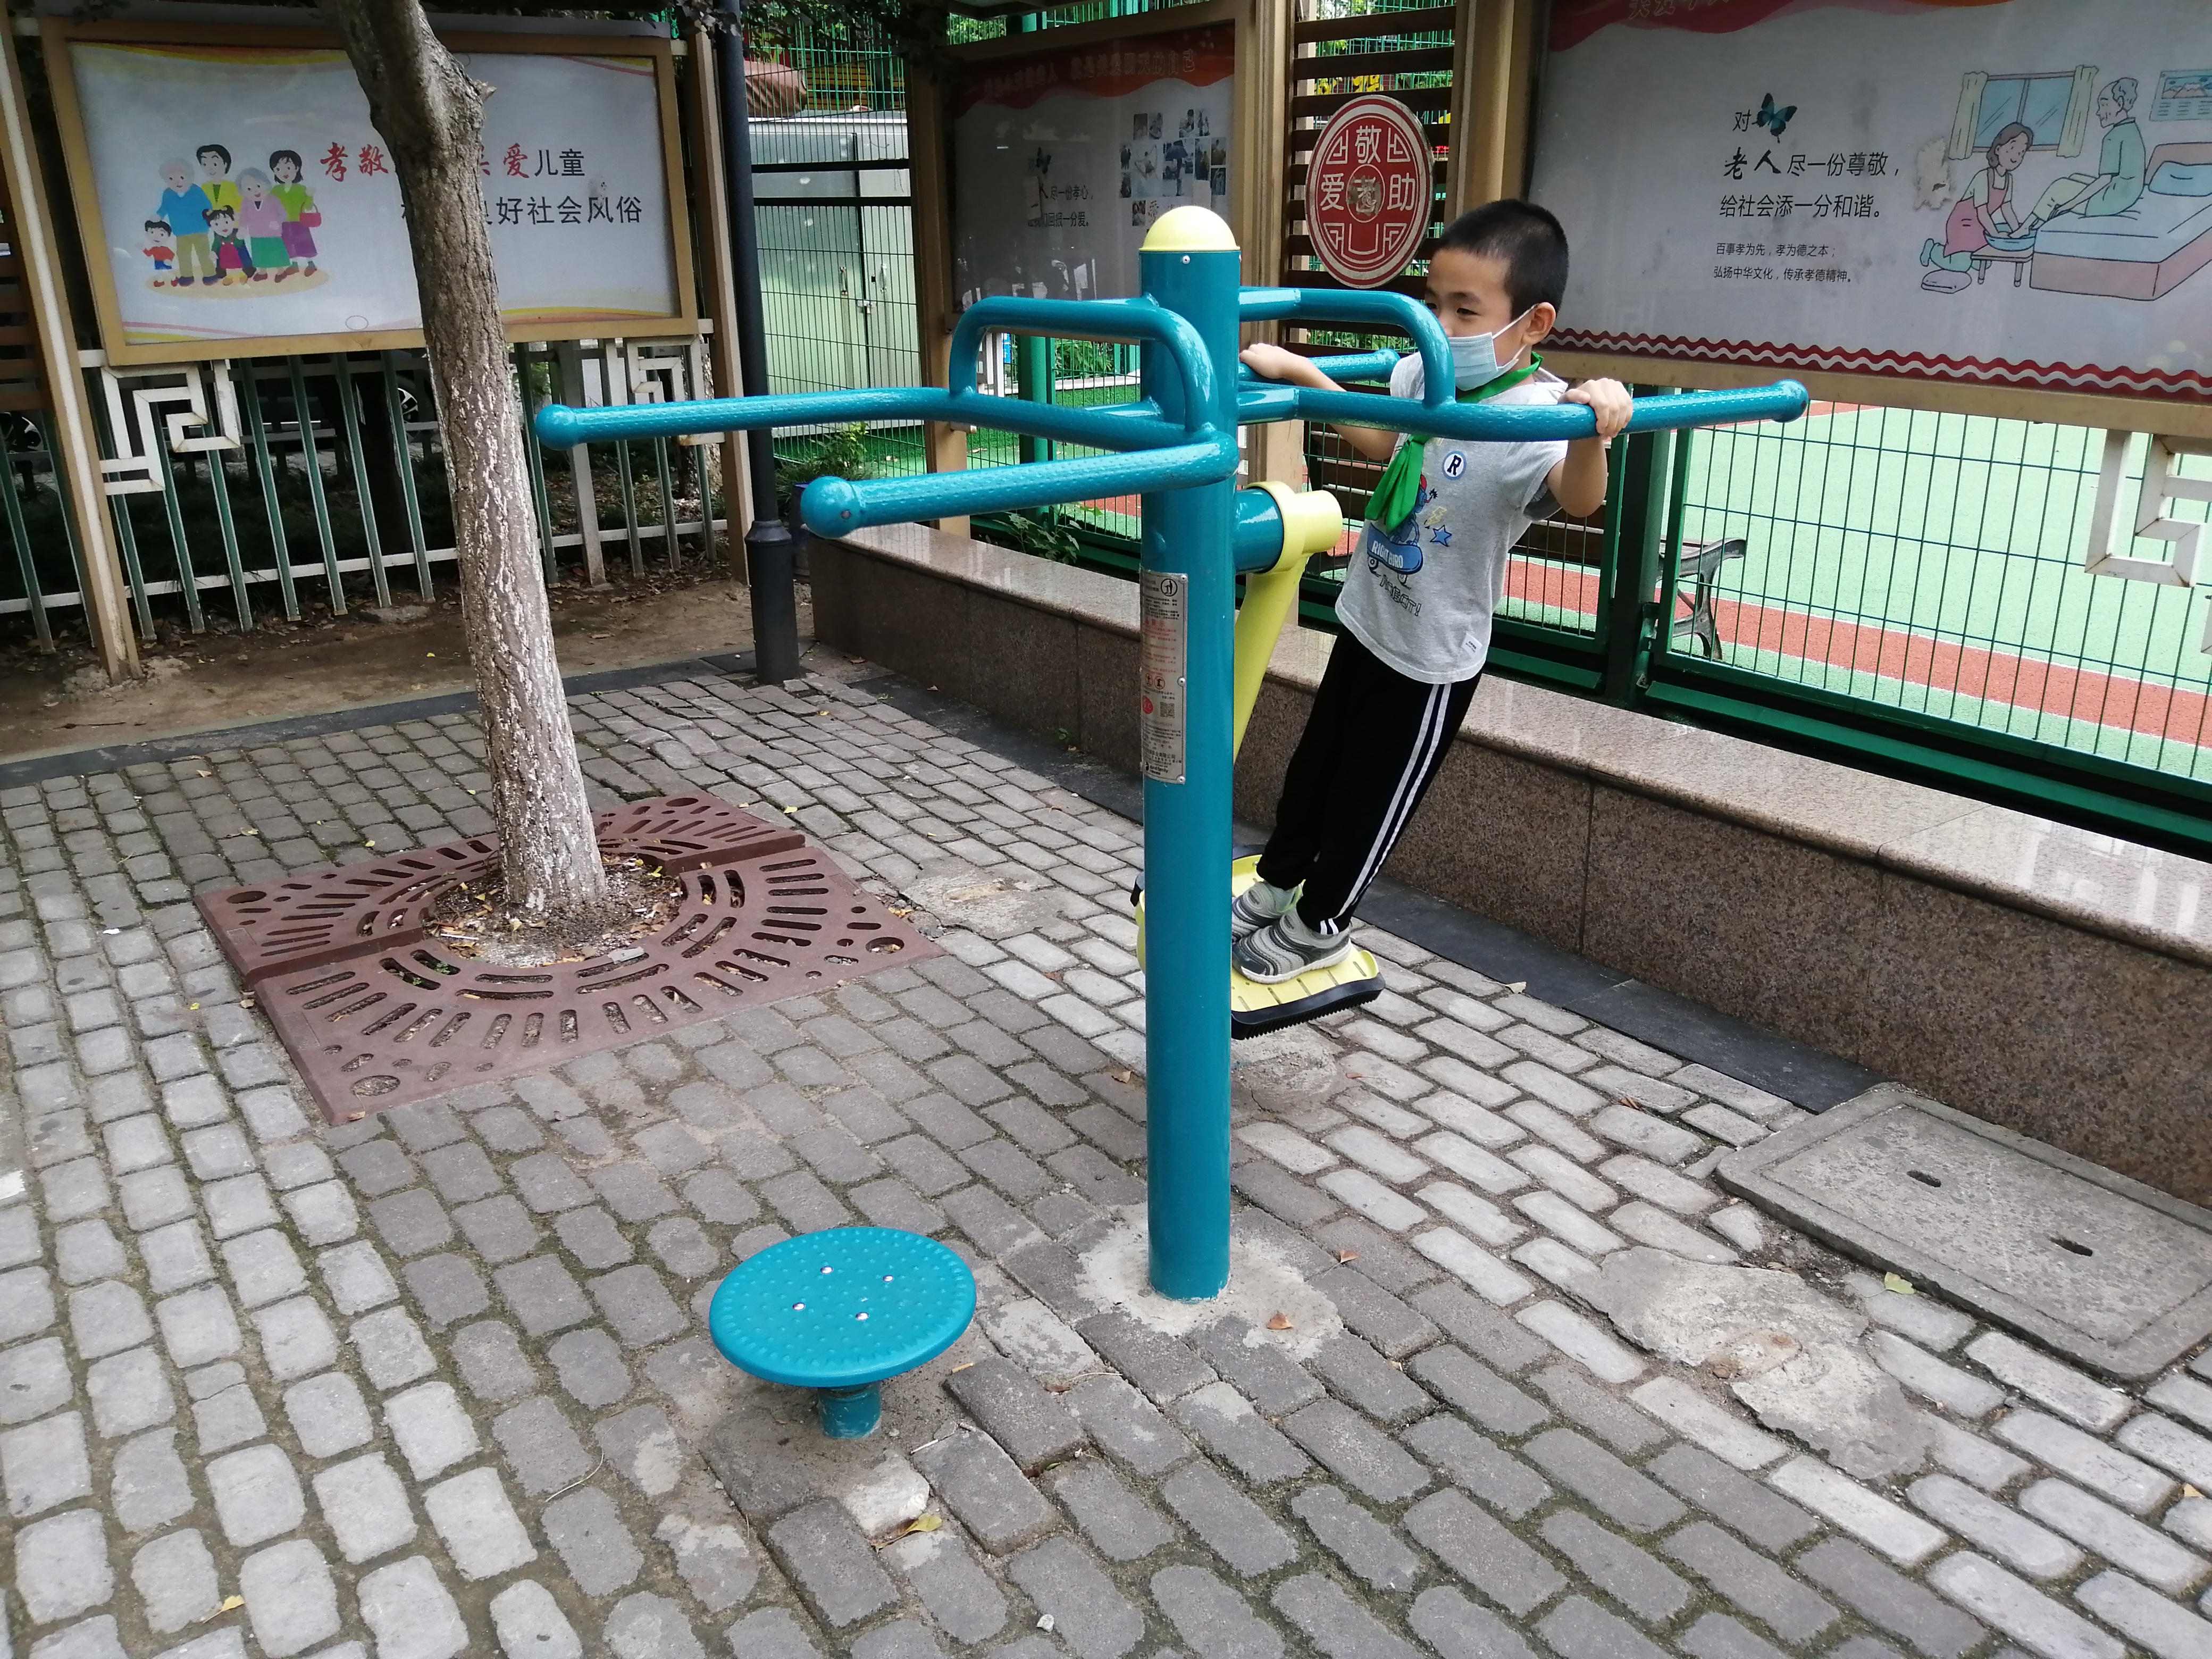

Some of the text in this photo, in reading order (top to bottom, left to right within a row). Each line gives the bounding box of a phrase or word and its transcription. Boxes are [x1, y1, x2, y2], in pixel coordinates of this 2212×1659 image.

[1732, 109, 1752, 132] 对
[1355, 125, 1382, 164] 敬
[320, 142, 389, 182] 孝敬
[1722, 146, 1899, 180] 老人尽一份尊敬，
[1319, 173, 1345, 211] 爱
[1387, 172, 1416, 211] 助
[1719, 194, 1880, 218] 给社会添一分和谐。
[1715, 242, 1836, 257] 百事孝为先，孝为德之本；
[1713, 266, 1851, 283] 弘扬中华文化，传承孝德精神。
[1447, 455, 1462, 476] R
[1371, 540, 1389, 562] RIGT
